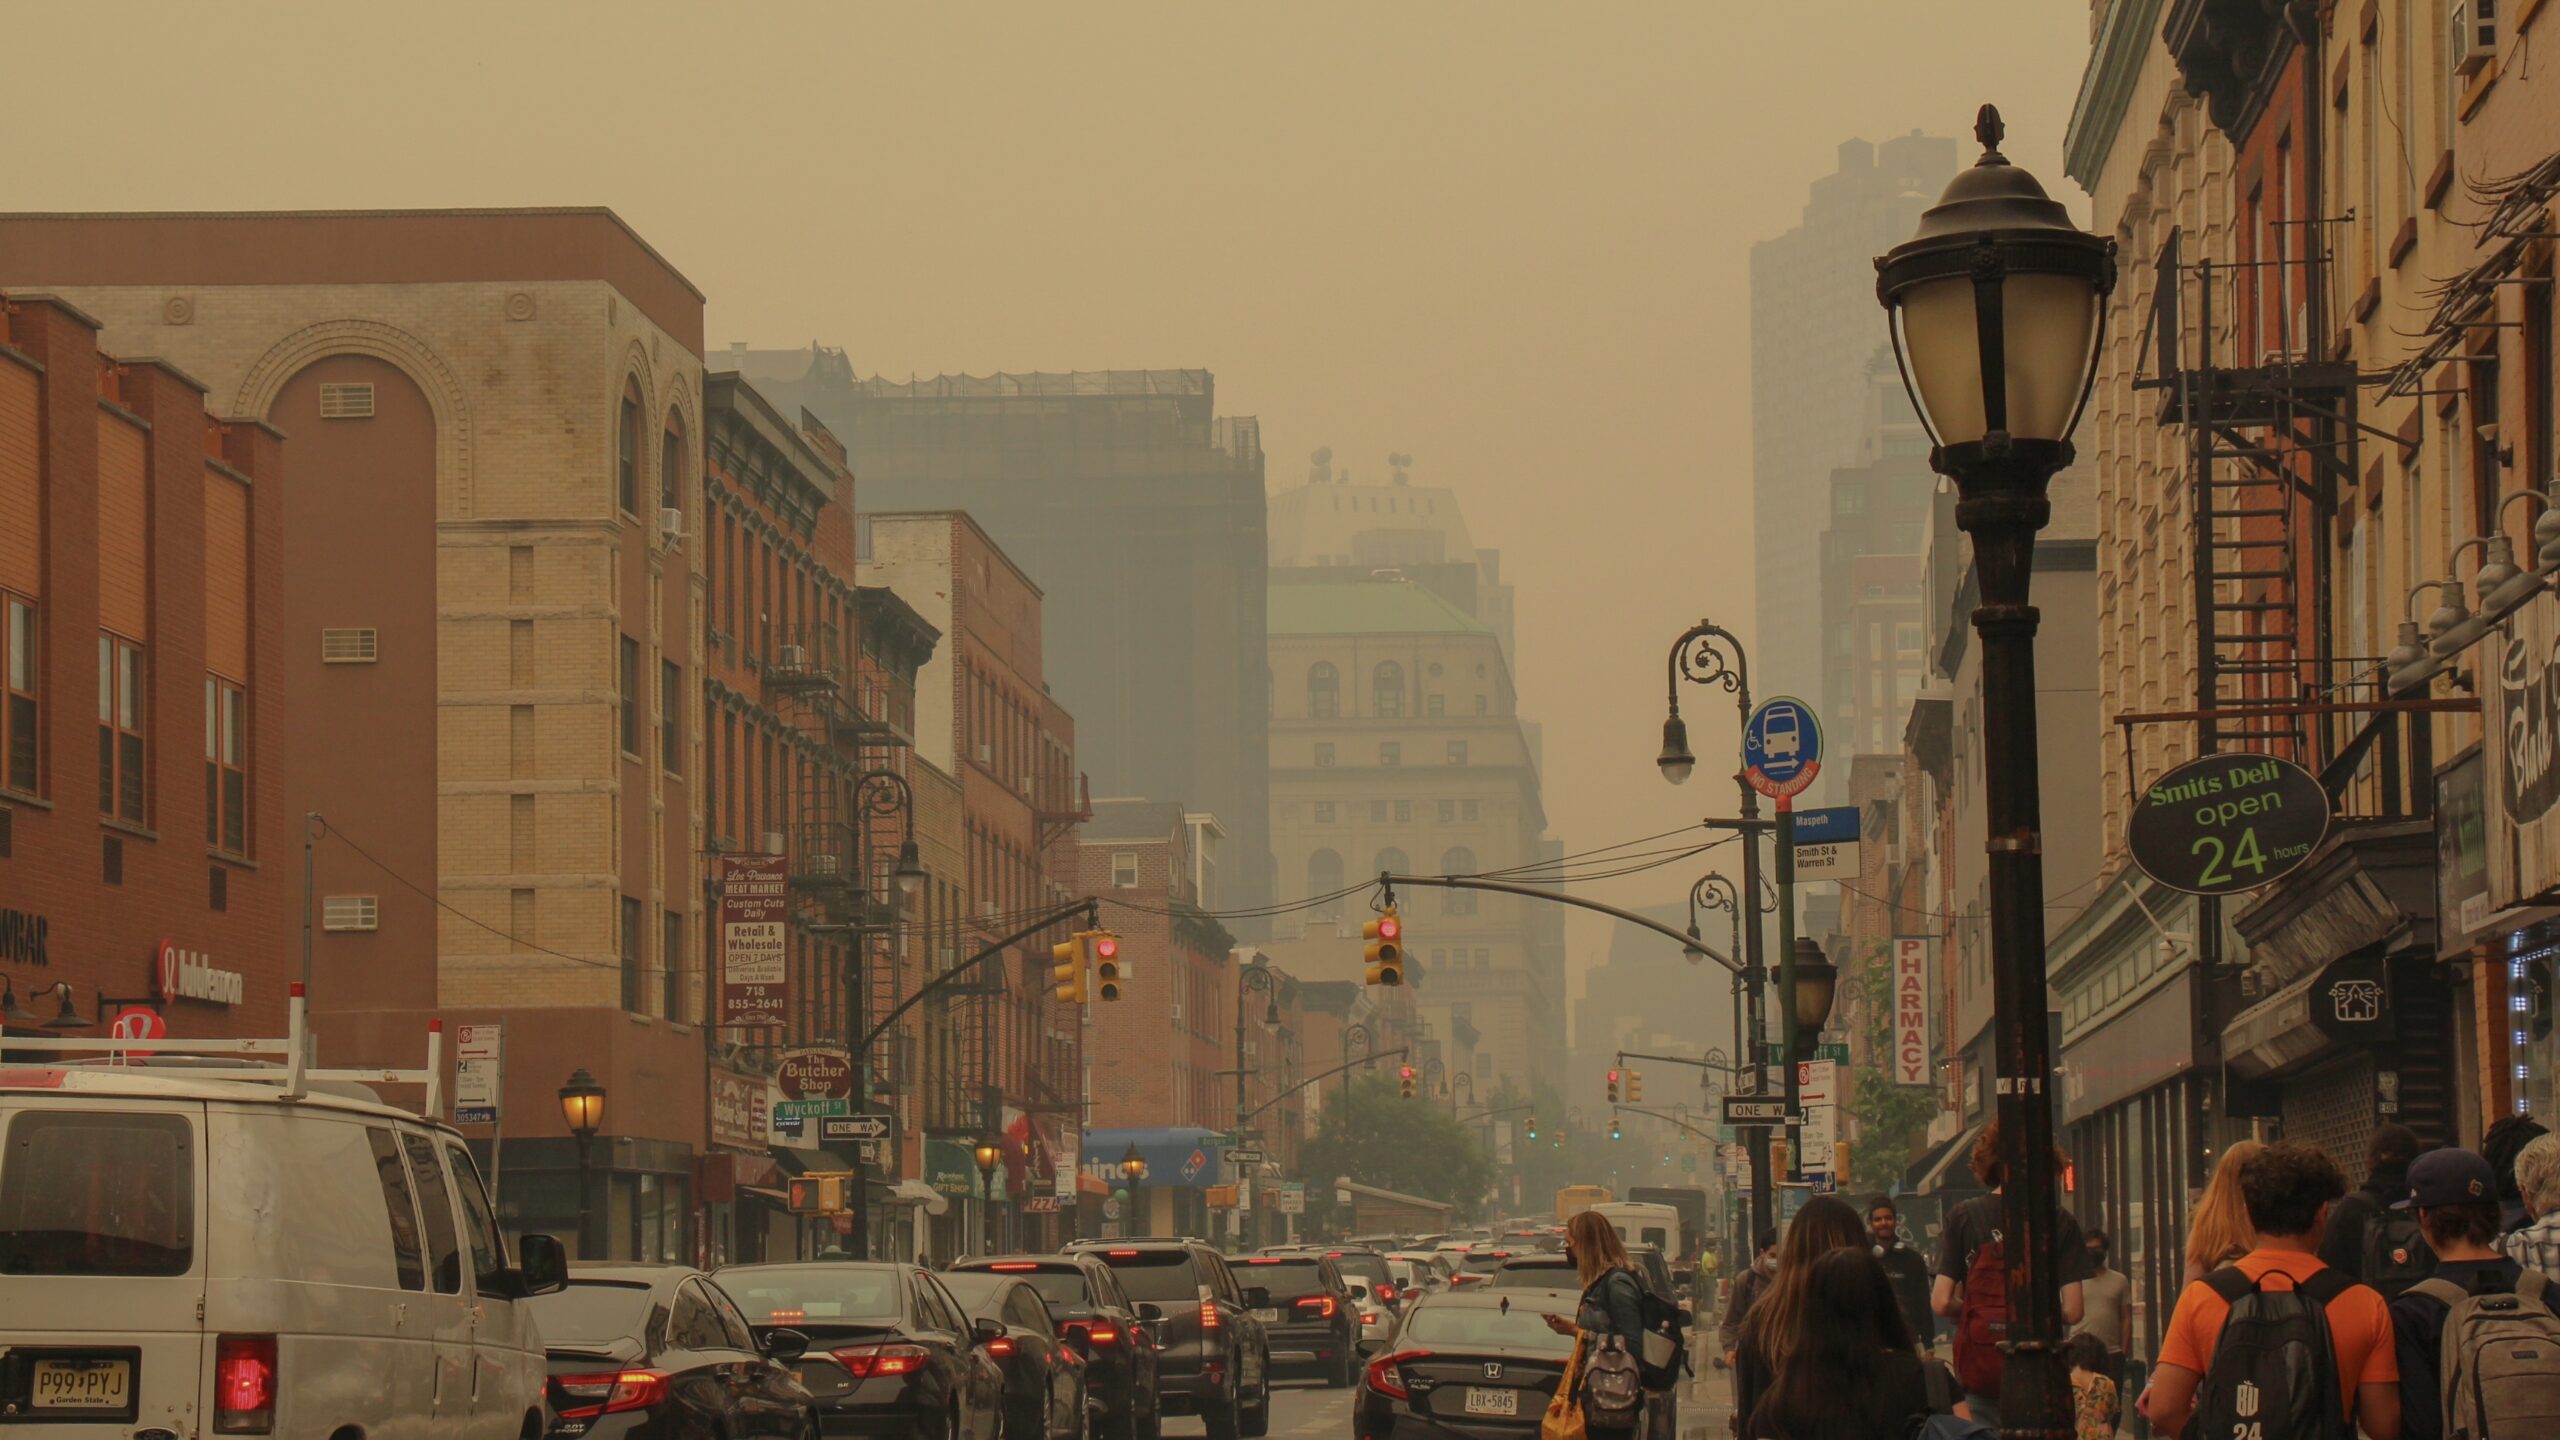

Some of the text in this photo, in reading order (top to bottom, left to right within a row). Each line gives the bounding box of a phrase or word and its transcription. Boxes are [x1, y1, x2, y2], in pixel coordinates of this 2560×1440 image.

[1749, 766, 1813, 795] NO STANDING
[2149, 760, 2280, 807] Smits Deli
[2195, 791, 2282, 827] open
[1796, 813, 1828, 827] Maspeth
[1796, 845, 1837, 858] Smith St &
[2191, 827, 2309, 887] 24 hours
[1797, 856, 1835, 868] Warren St
[725, 884, 784, 893] MEAT MARKET
[727, 899, 785, 908] Custom Cuts
[744, 909, 766, 919] Daily
[734, 925, 775, 936] Retail &
[728, 938, 783, 950] Wholesale
[728, 953, 751, 962] OPEN
[760, 953, 782, 962] DAYS
[178, 949, 242, 1005] lululemon
[746, 986, 765, 996] 718
[1900, 940, 1923, 1081] PHARMACY
[806, 1054, 825, 1064] The
[786, 1062, 845, 1077] Butcher
[799, 1078, 832, 1091] Shop
[784, 1101, 841, 1118] Wyckoff St
[1735, 1105, 1761, 1116] ONE
[1800, 1107, 1807, 1125] 2
[832, 1123, 880, 1133] ONE WAY
[932, 1184, 969, 1193] GIFT SHOP
[2233, 1422, 2262, 1440] 24
